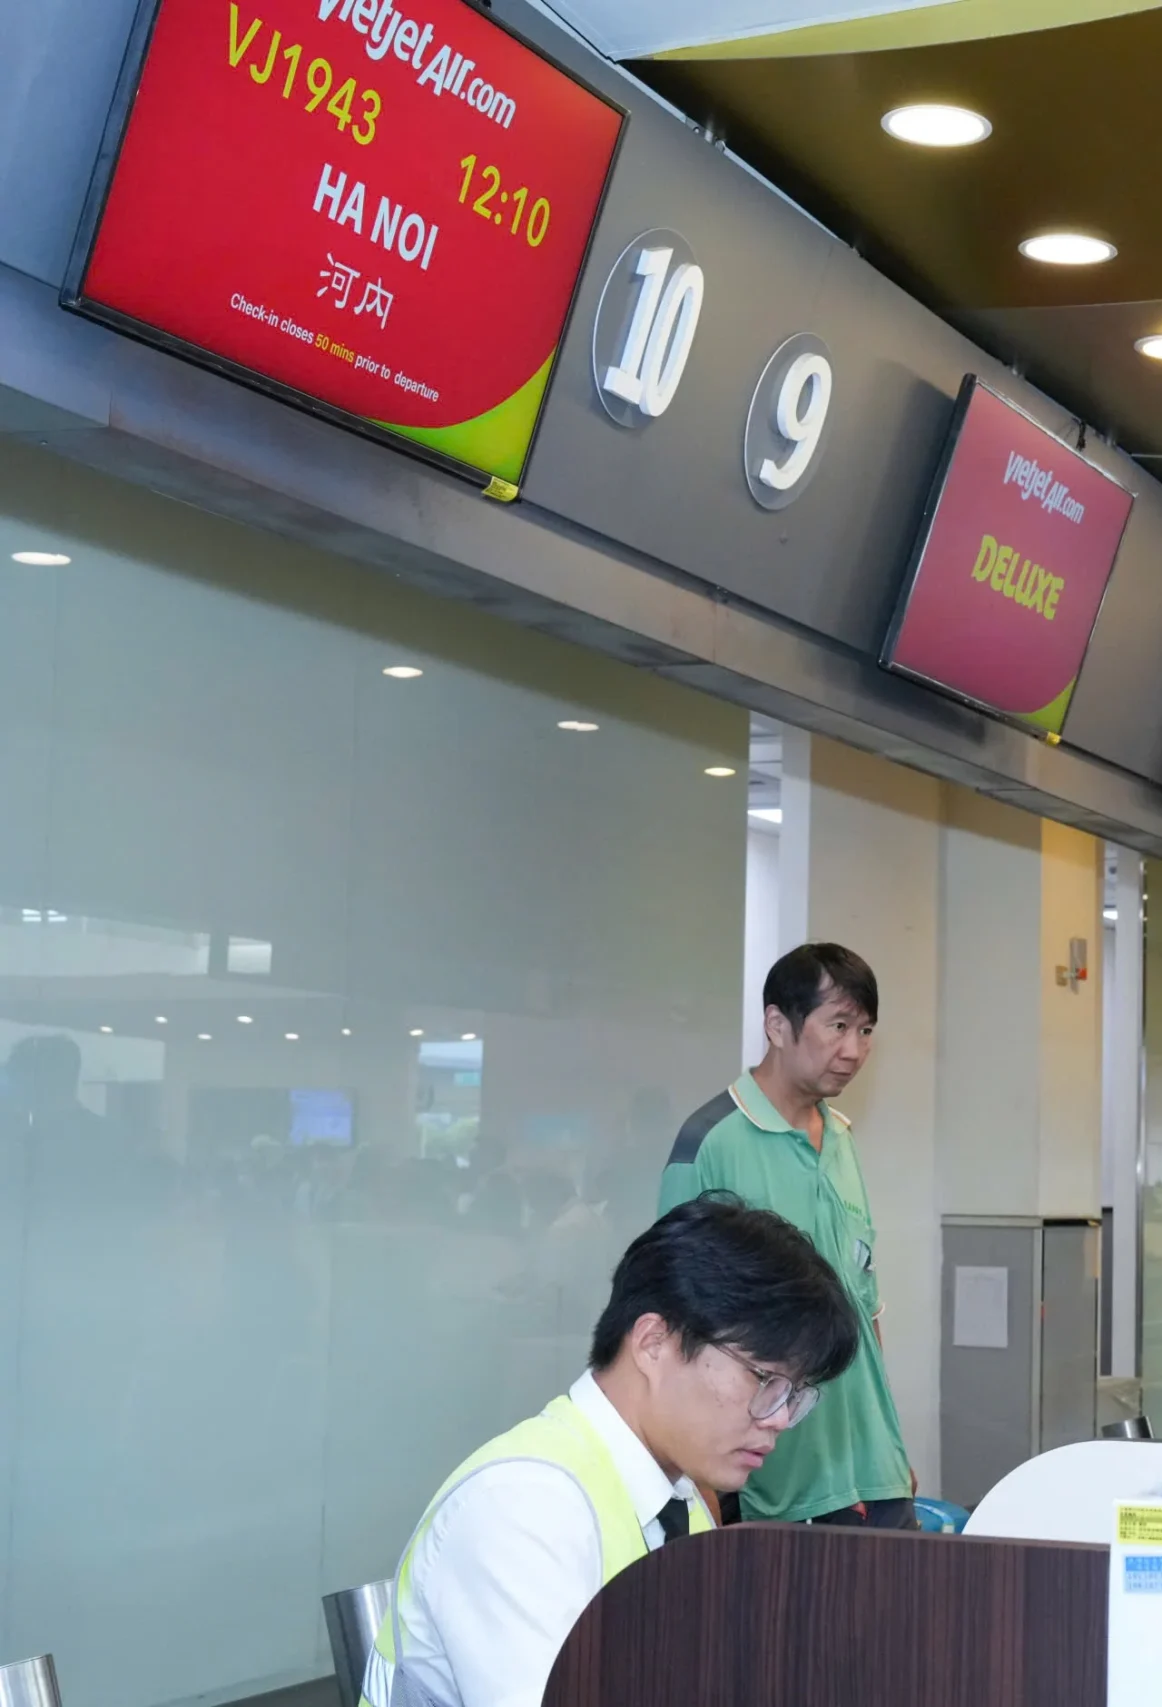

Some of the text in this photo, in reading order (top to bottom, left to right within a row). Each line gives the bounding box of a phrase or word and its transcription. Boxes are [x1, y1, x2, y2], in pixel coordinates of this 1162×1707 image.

[226, 2, 383, 146] VJ1943
[312, 162, 439, 271] HA NOI
[458, 154, 551, 248] 12:10
[230, 293, 439, 402] Check-in closes 50 mins prior to departure
[602, 246, 705, 418] 10
[758, 351, 833, 492] 9
[970, 533, 1064, 621] DELUXE
